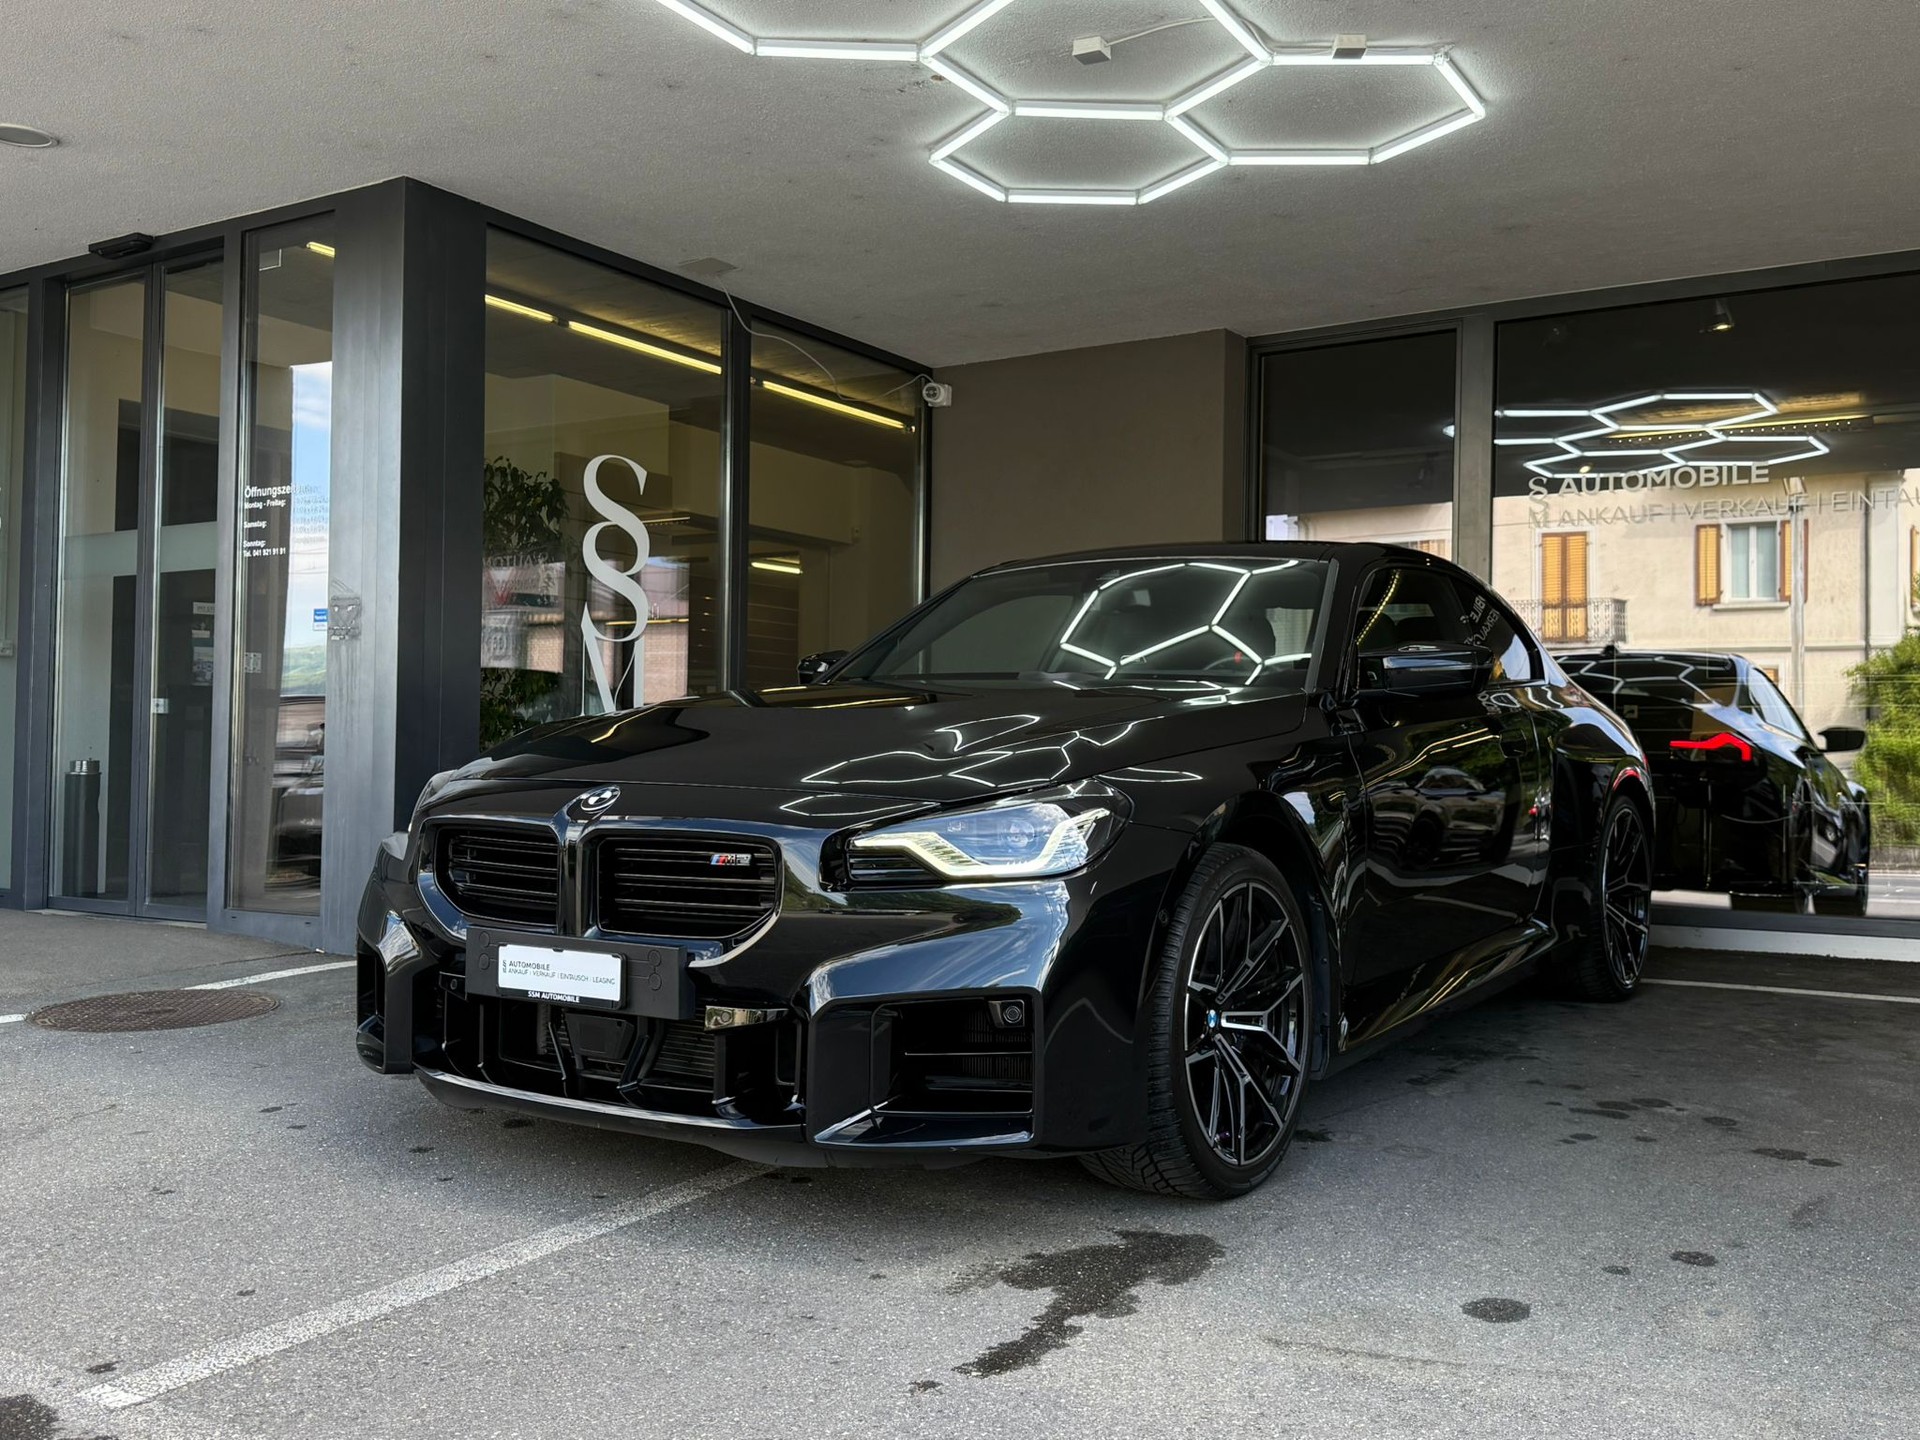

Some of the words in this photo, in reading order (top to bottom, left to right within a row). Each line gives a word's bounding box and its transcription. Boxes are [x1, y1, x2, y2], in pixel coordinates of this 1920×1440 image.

[1558, 462, 1769, 497] AUTOMOBILE
[1558, 503, 1663, 527] ANKAUF
[1683, 493, 1808, 520] VERKAUF
[509, 961, 550, 971] AUTOMOBILE
[528, 990, 540, 999] SSM
[541, 992, 580, 1003] AUTOMOBILE
